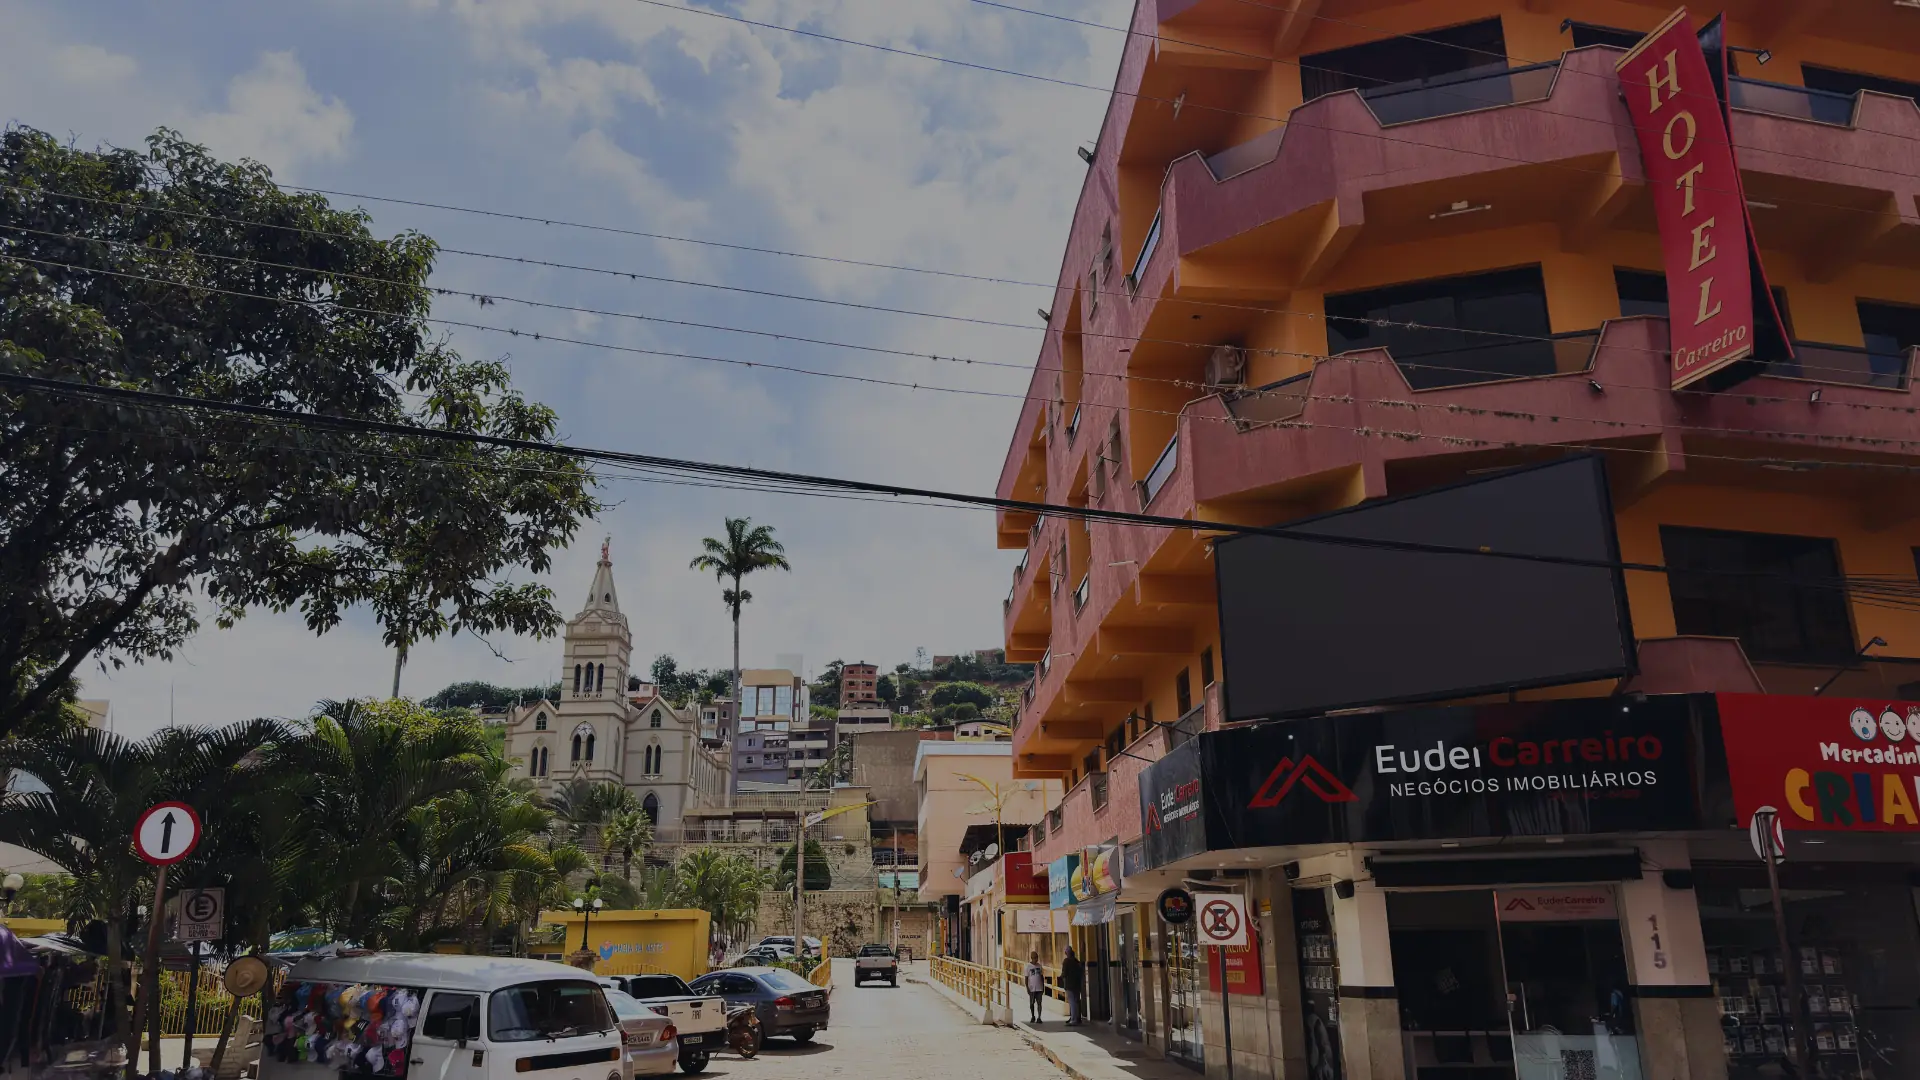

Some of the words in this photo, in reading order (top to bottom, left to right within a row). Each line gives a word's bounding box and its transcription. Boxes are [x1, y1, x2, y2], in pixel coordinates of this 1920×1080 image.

[1645, 49, 1722, 326] HOTEL
[1673, 324, 1747, 372] Carreiro
[1488, 730, 1663, 767] Carreiro
[1390, 777, 1500, 797] NEGÓCIOS
[1506, 769, 1658, 792] IMOBILIÁRIOS
[1785, 767, 1920, 826] CRIA
[1648, 914, 1667, 969] 115
